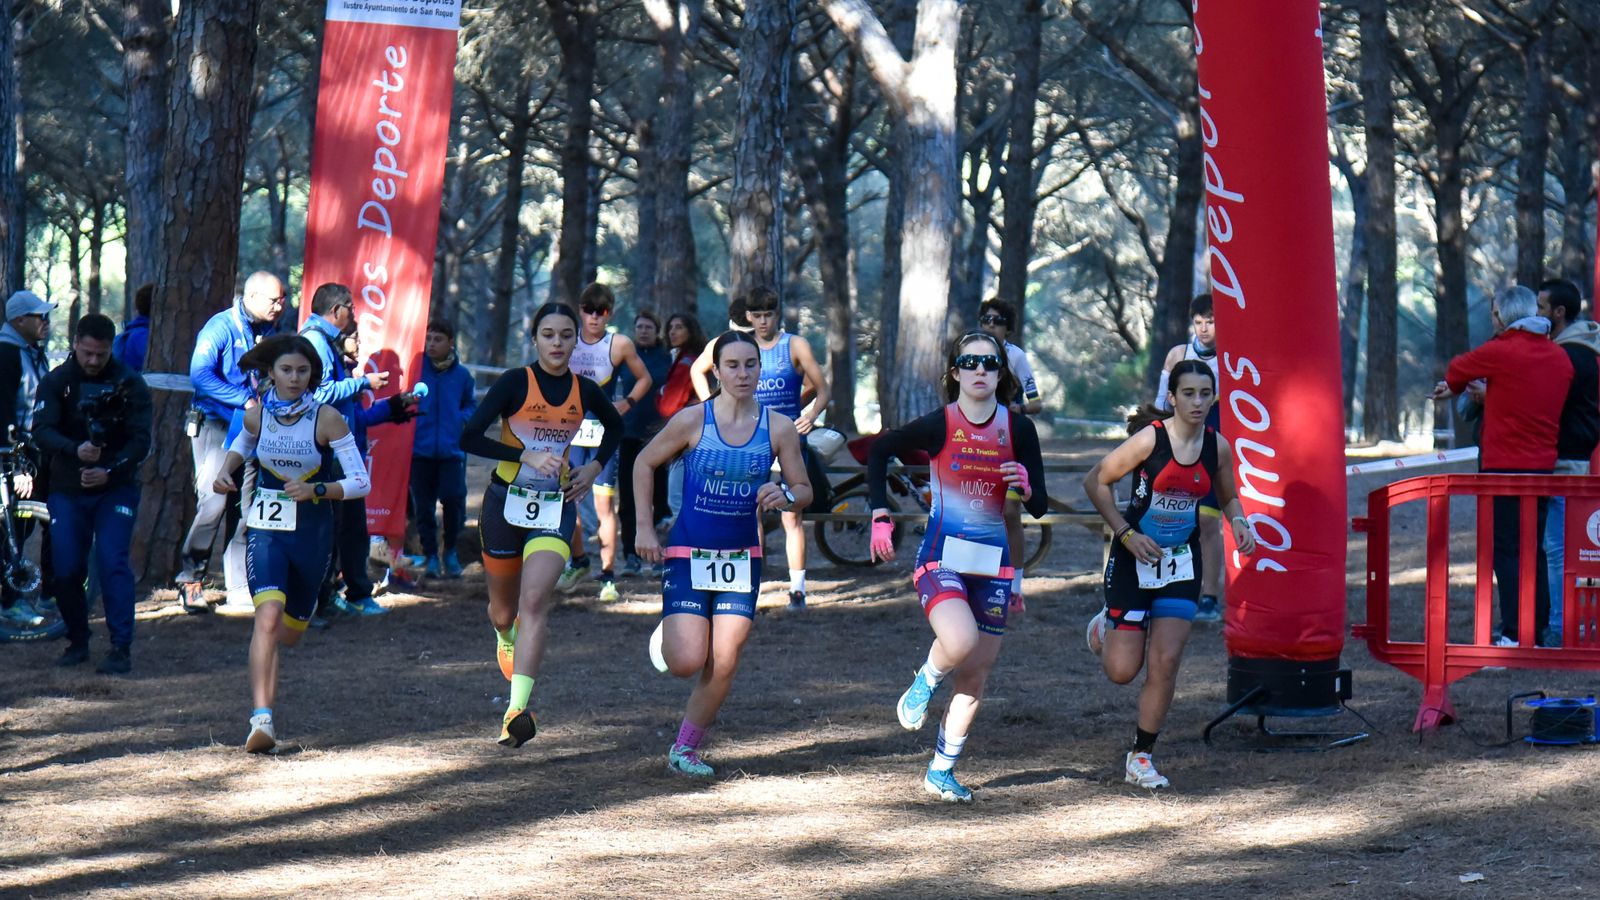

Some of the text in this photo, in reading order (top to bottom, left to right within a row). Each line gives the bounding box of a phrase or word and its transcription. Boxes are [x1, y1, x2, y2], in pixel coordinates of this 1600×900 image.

[364, 2, 408, 14] Ayuntamiento
[410, 6, 418, 14] de
[420, 7, 434, 16] San
[435, 8, 454, 18] Roque
[357, 45, 408, 239] Deporte
[268, 440, 312, 448] MONTEROS
[534, 427, 570, 443] TORRES
[270, 459, 302, 468] TORO
[704, 478, 751, 497] NIETO
[960, 478, 996, 496] MUÑOZ
[257, 500, 282, 521] 12
[526, 502, 540, 520] 9
[1155, 497, 1194, 510] AROA
[706, 562, 736, 584] 10
[1152, 558, 1176, 580] 11
